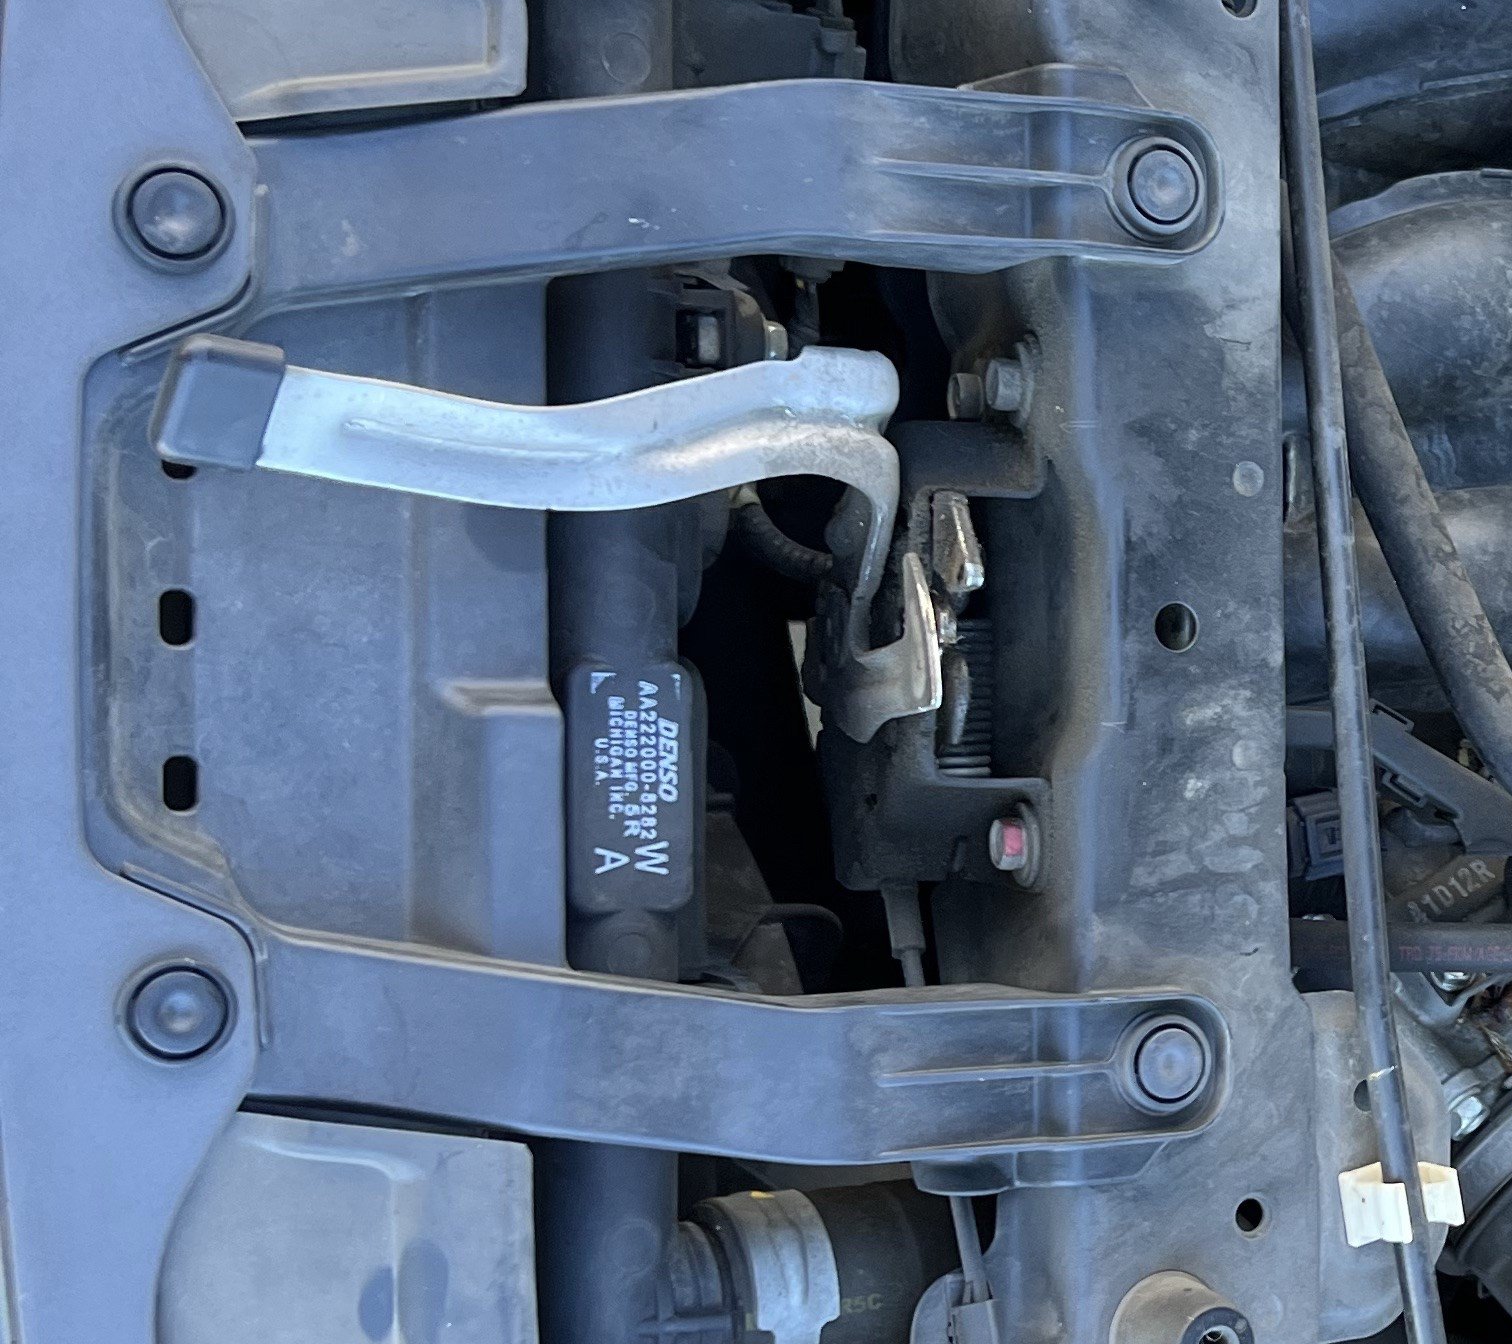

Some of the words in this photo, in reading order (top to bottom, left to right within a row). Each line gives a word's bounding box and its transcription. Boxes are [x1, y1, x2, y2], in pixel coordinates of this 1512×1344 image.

[606, 696, 624, 778] MICHIGAN
[623, 709, 638, 758] DENSO
[656, 717, 678, 804] DENSO
[607, 785, 624, 820] INC.
[592, 846, 630, 874] A
[632, 839, 669, 875] W
